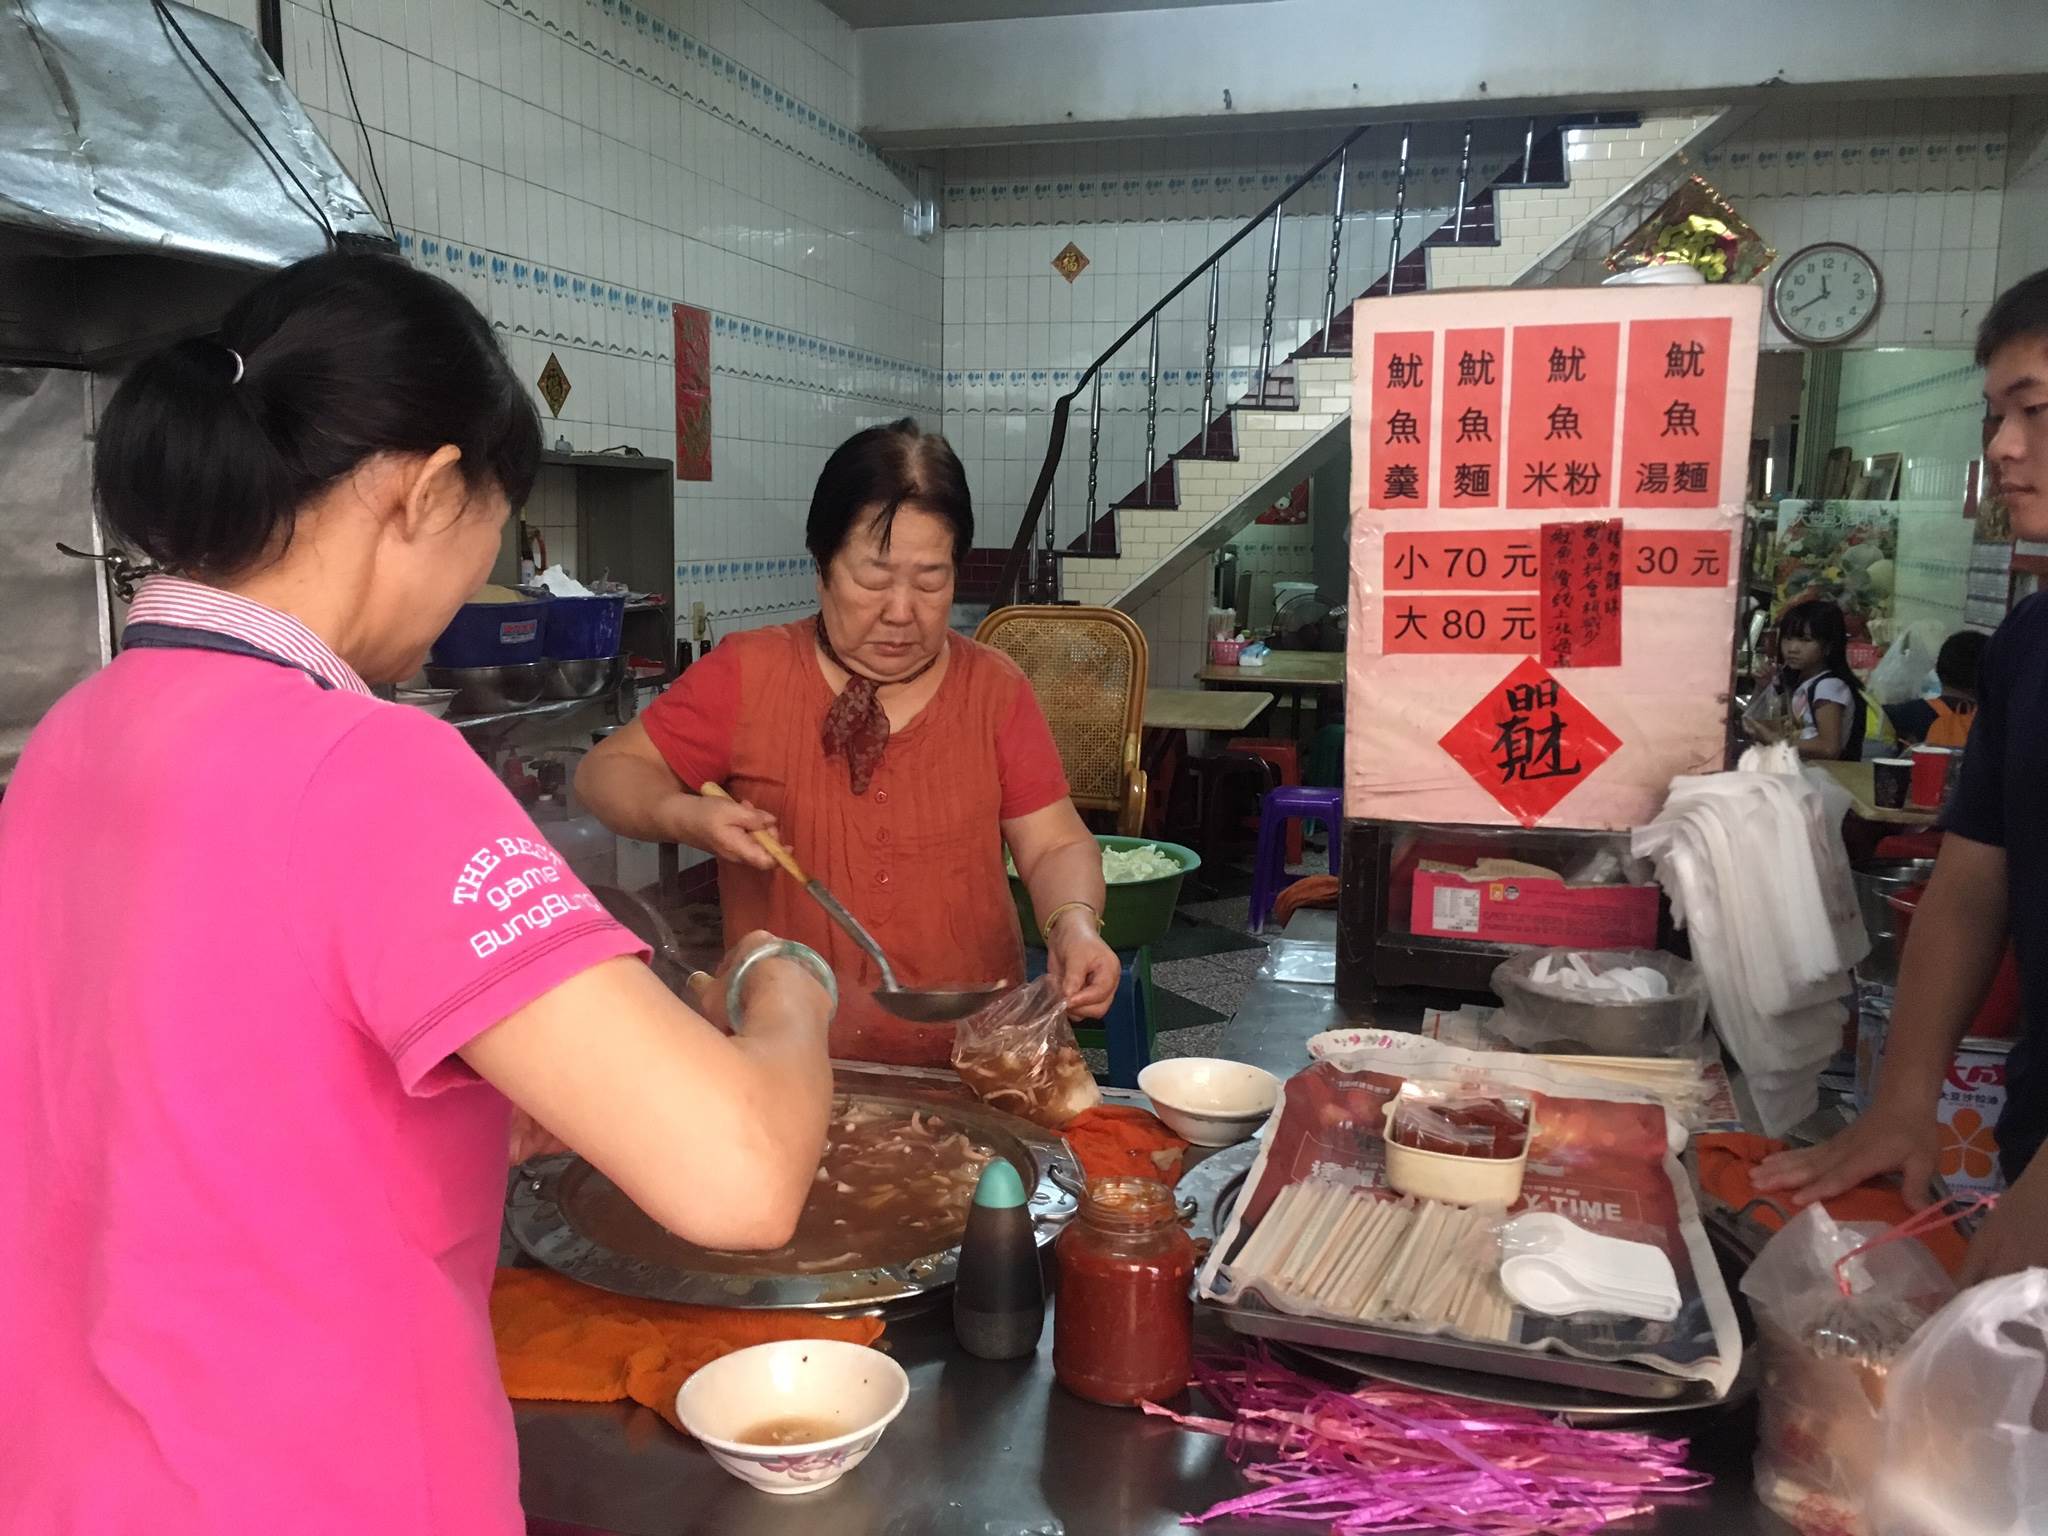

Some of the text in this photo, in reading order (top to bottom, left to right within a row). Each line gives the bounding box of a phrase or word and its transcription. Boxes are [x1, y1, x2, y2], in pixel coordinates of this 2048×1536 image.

[452, 847, 502, 905] THE
[486, 866, 560, 912] game
[1549, 1195, 1623, 1223] TIME
